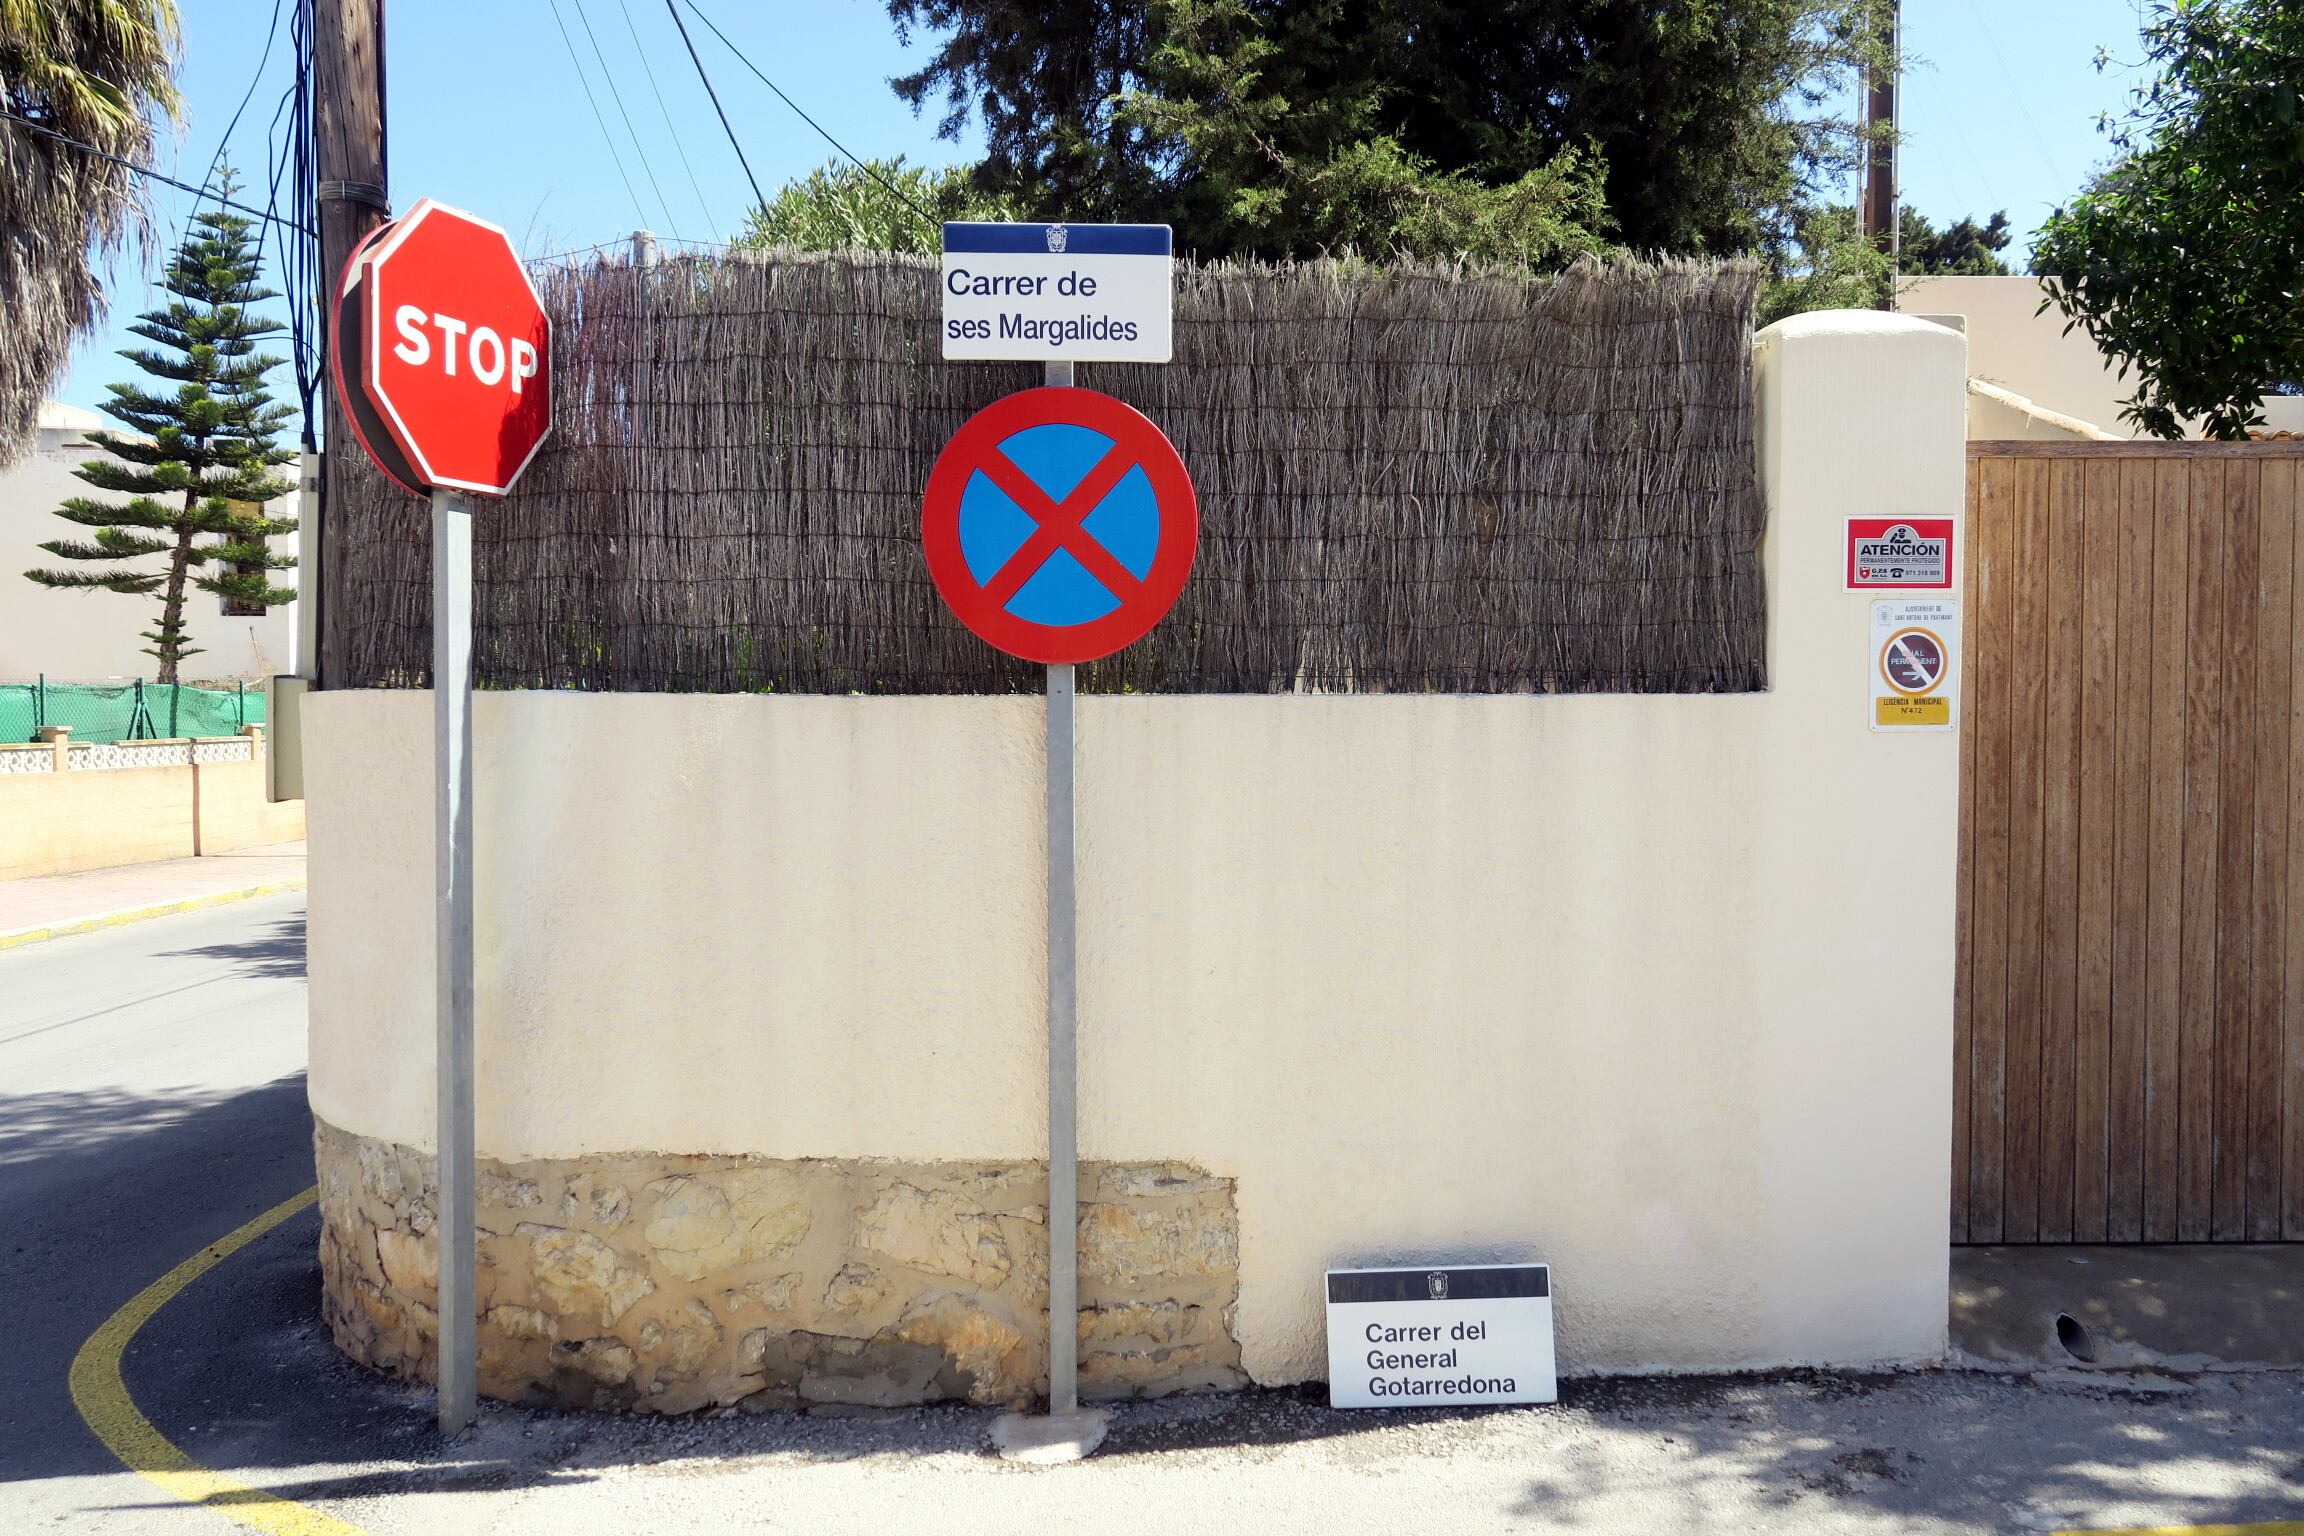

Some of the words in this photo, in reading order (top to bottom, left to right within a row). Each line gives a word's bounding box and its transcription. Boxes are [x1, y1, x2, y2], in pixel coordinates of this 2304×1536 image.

[947, 268, 1048, 297] Carrer
[1057, 270, 1098, 297] de
[947, 318, 992, 340] ses
[999, 312, 1139, 347] Margalides
[393, 304, 539, 394] STOP
[1860, 542, 1940, 556] ATENCIÓN
[1914, 697, 1942, 705] MUNICIPAL
[1365, 1323, 1441, 1343] Carrer
[1450, 1321, 1486, 1340] del
[1367, 1348, 1457, 1369] General
[1369, 1375, 1516, 1396] Gotarredona
